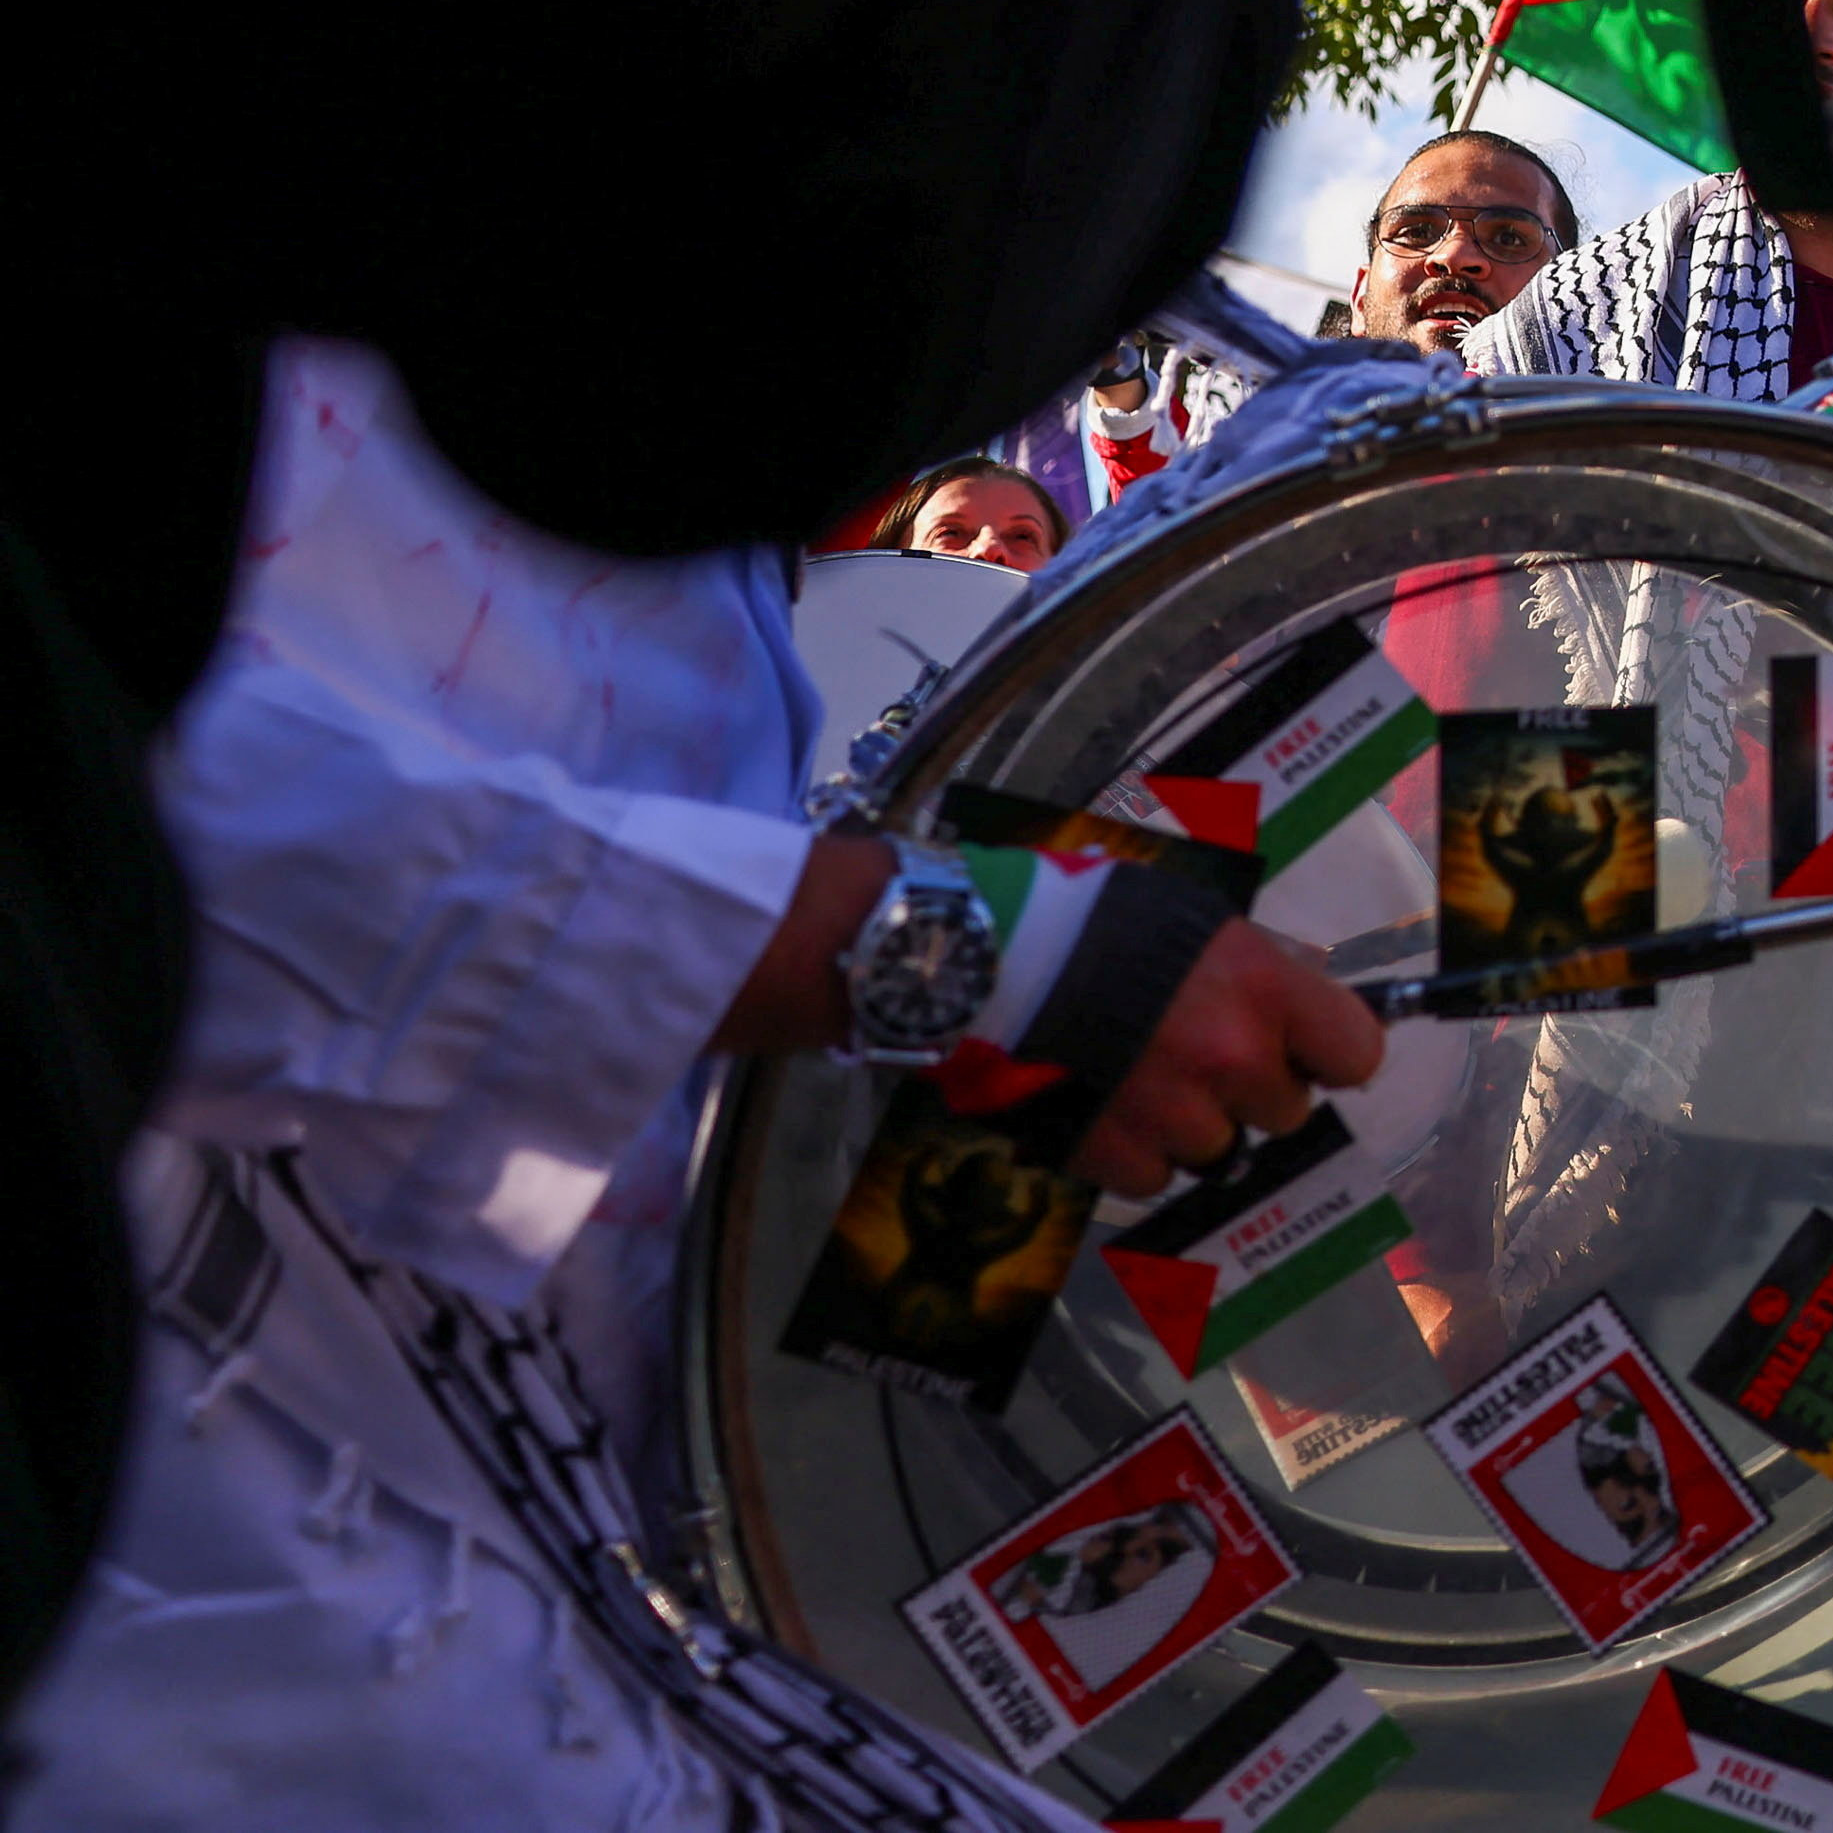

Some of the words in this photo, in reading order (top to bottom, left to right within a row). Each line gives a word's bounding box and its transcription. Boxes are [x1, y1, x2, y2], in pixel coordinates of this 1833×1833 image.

[1262, 716, 1322, 771] FREE
[1279, 696, 1385, 786] PALESTINE
[1225, 1201, 1288, 1253] FREE
[1239, 1187, 1352, 1270] PALESTINE
[1226, 1743, 1287, 1804] FREE
[1244, 1718, 1350, 1820] PALESTINE
[1717, 1755, 1778, 1793] FREE
[1706, 1778, 1816, 1830] PALESTINE
